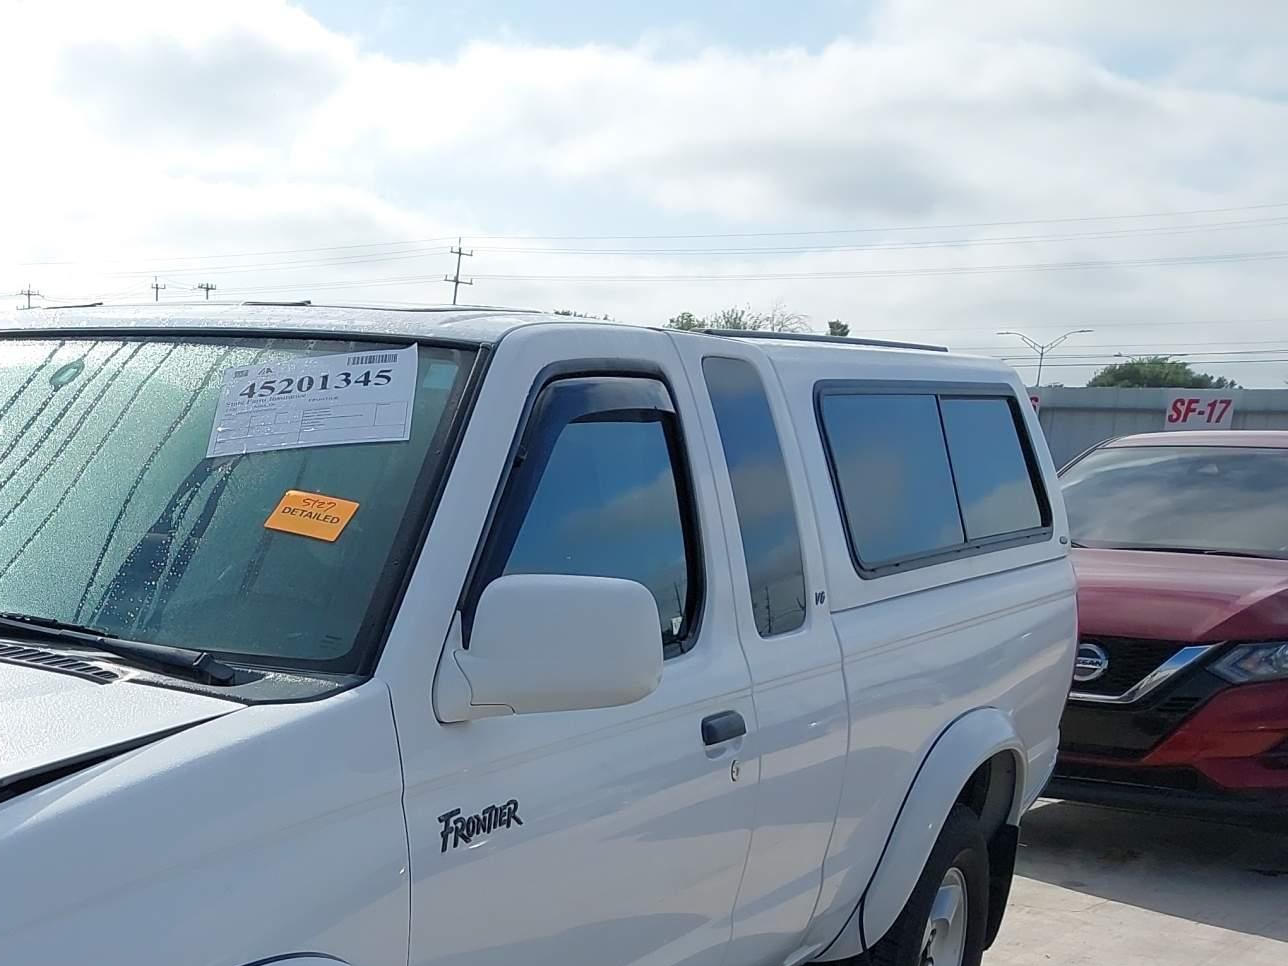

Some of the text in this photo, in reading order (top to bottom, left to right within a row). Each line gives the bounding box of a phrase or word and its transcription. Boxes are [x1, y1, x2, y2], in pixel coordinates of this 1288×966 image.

[239, 369, 393, 398] 45201345
[1167, 398, 1233, 424] SF-17
[281, 506, 341, 525] DETAILED
[437, 799, 524, 853] FRONTIER
